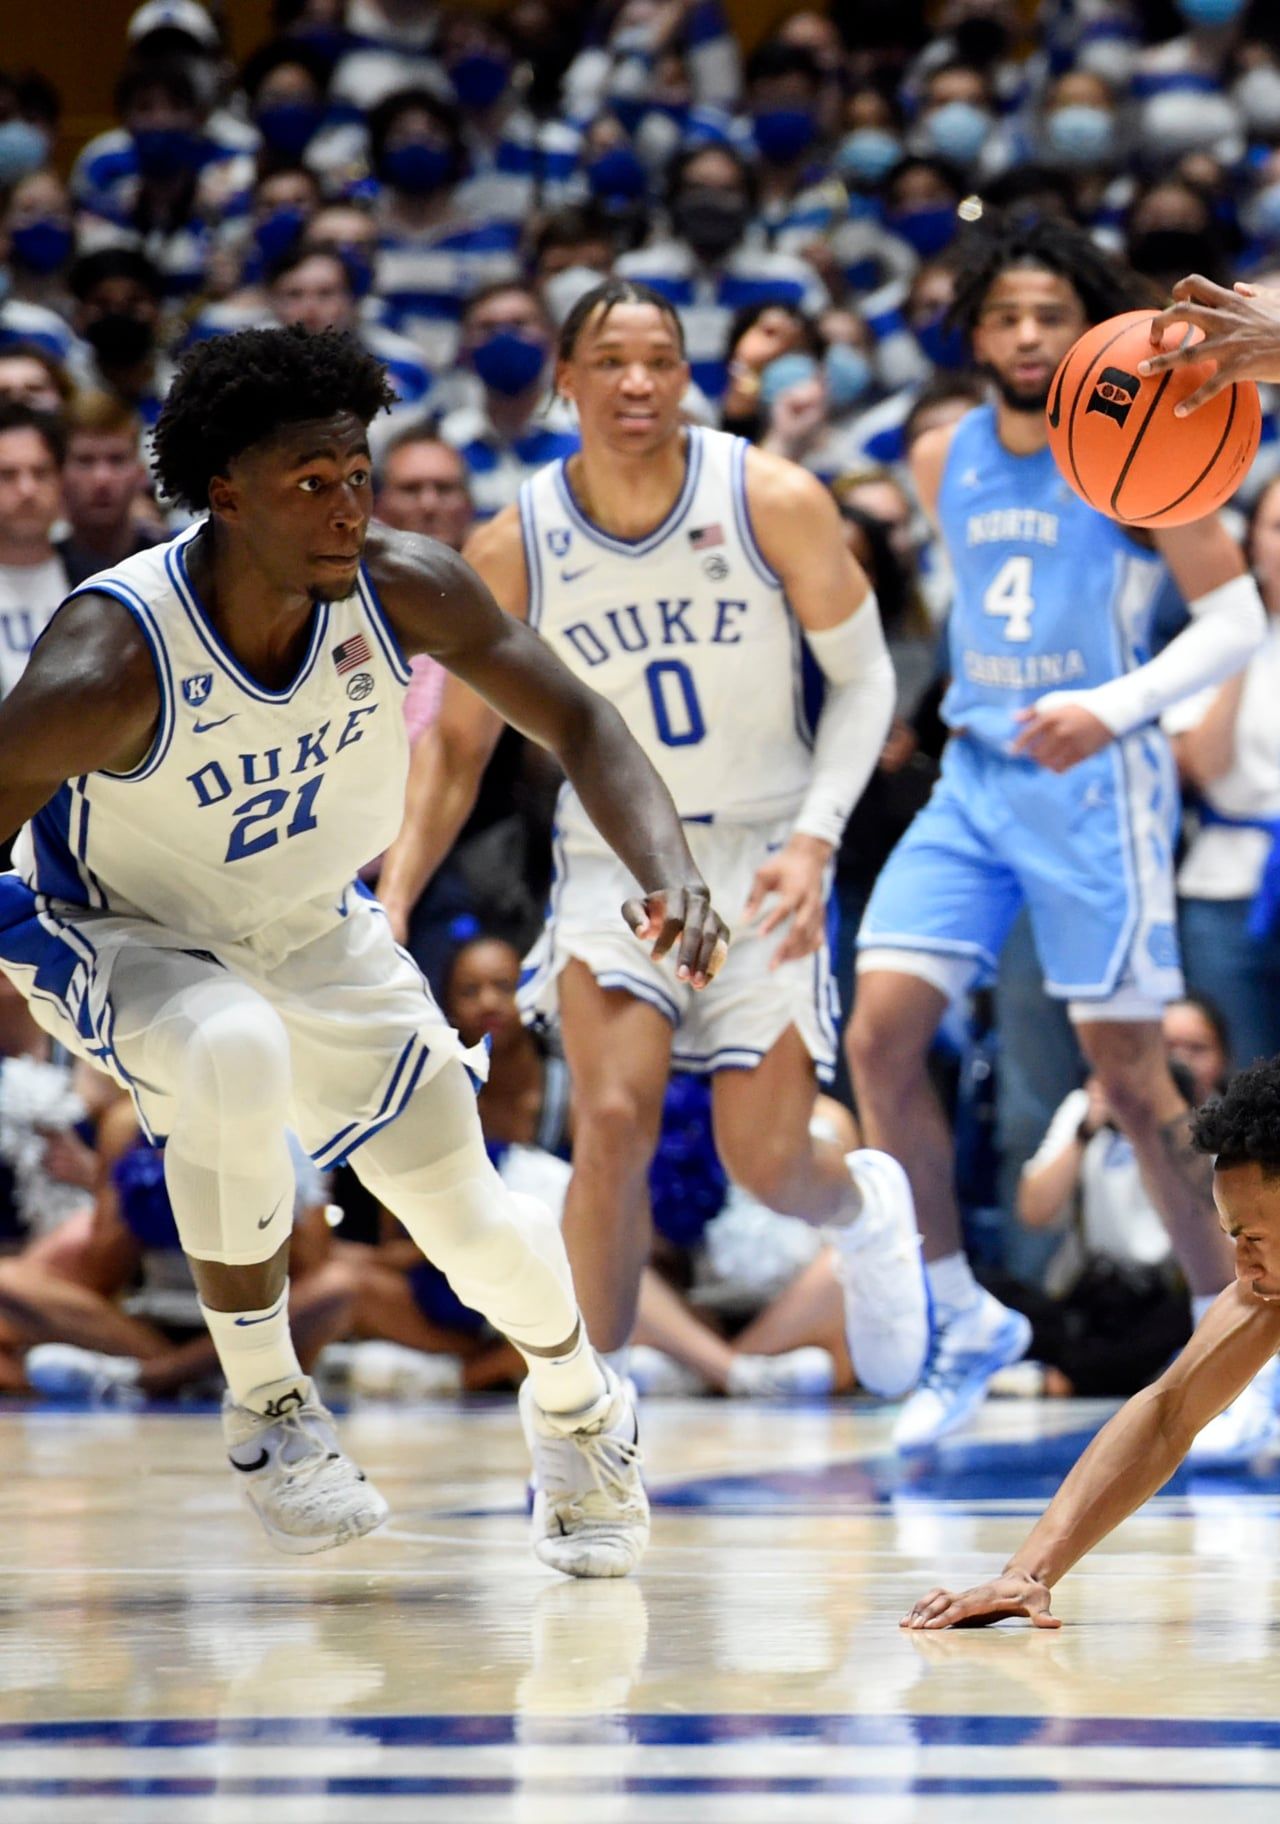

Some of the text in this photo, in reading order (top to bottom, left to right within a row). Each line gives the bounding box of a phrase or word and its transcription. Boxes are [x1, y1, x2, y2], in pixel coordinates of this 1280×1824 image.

[966, 507, 1061, 548] NORTH
[562, 598, 748, 667] DUKE
[982, 553, 1036, 643] 4
[643, 657, 708, 749] 0
[185, 703, 380, 808] DUKE
[223, 772, 326, 865] 21
